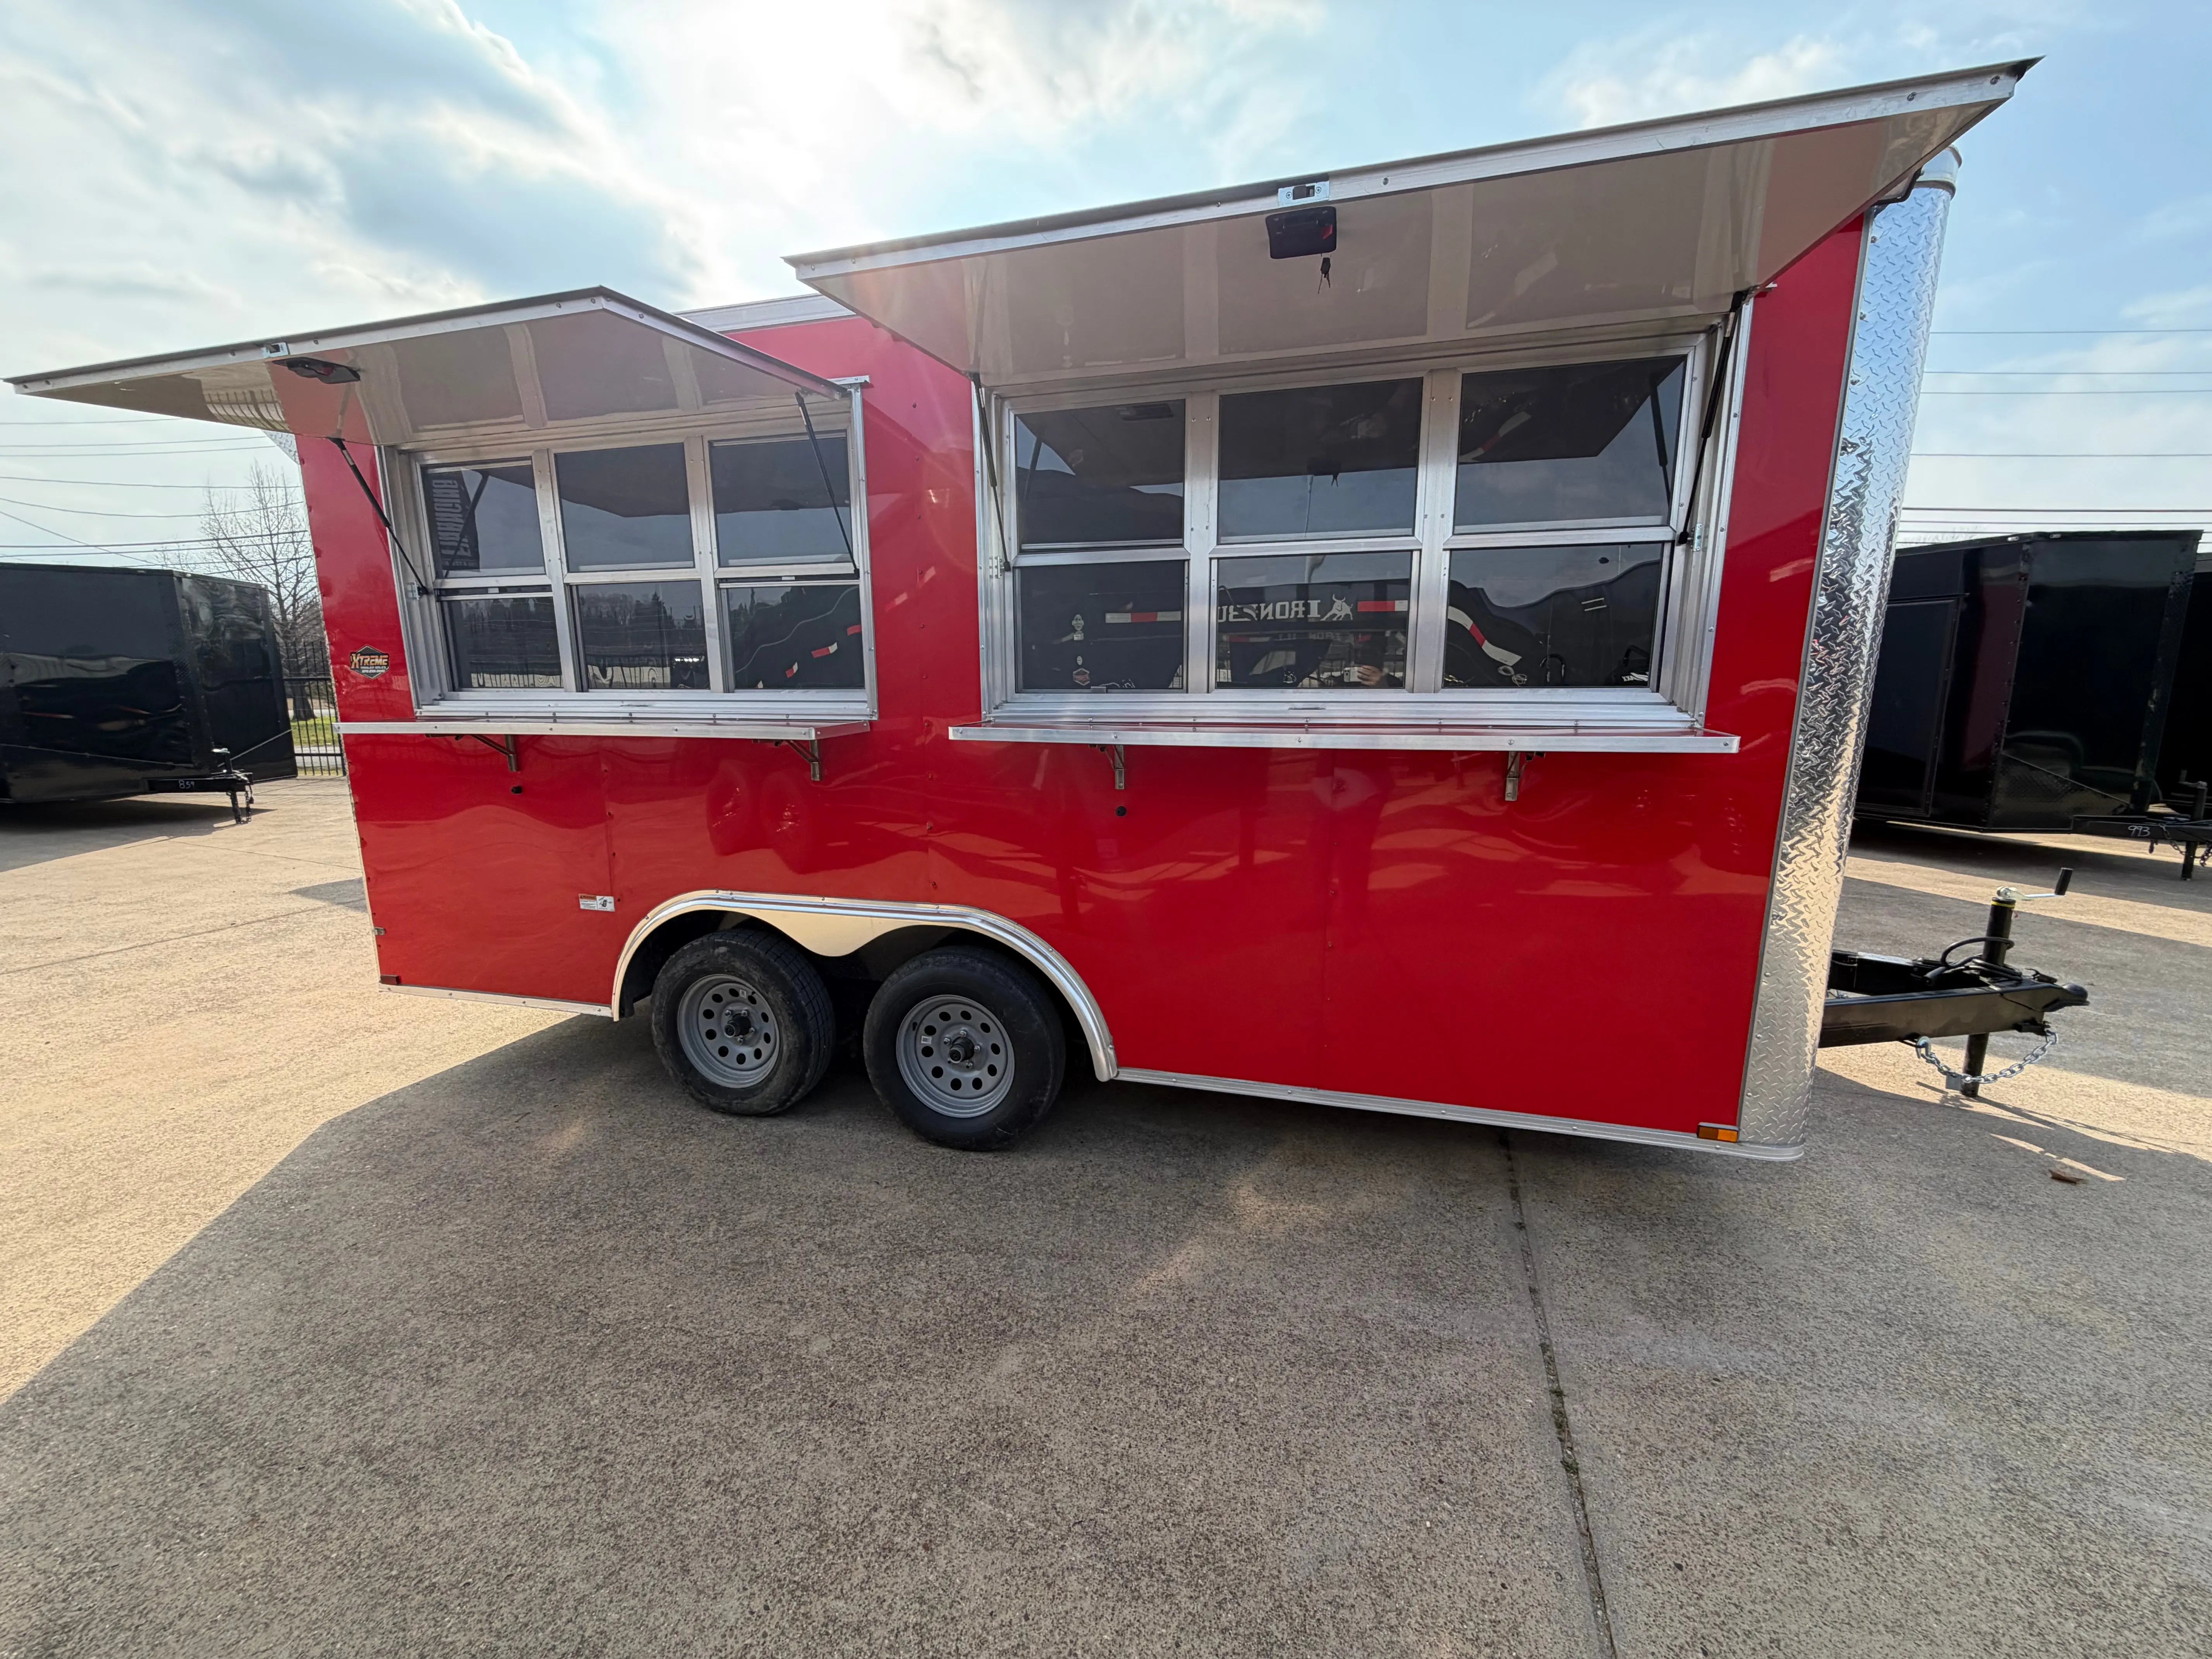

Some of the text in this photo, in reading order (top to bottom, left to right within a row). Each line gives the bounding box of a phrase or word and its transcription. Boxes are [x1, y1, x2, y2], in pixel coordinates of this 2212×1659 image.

[350, 653, 388, 669] XTREME
[179, 780, 195, 789] 859
[2128, 825, 2150, 837] 993
